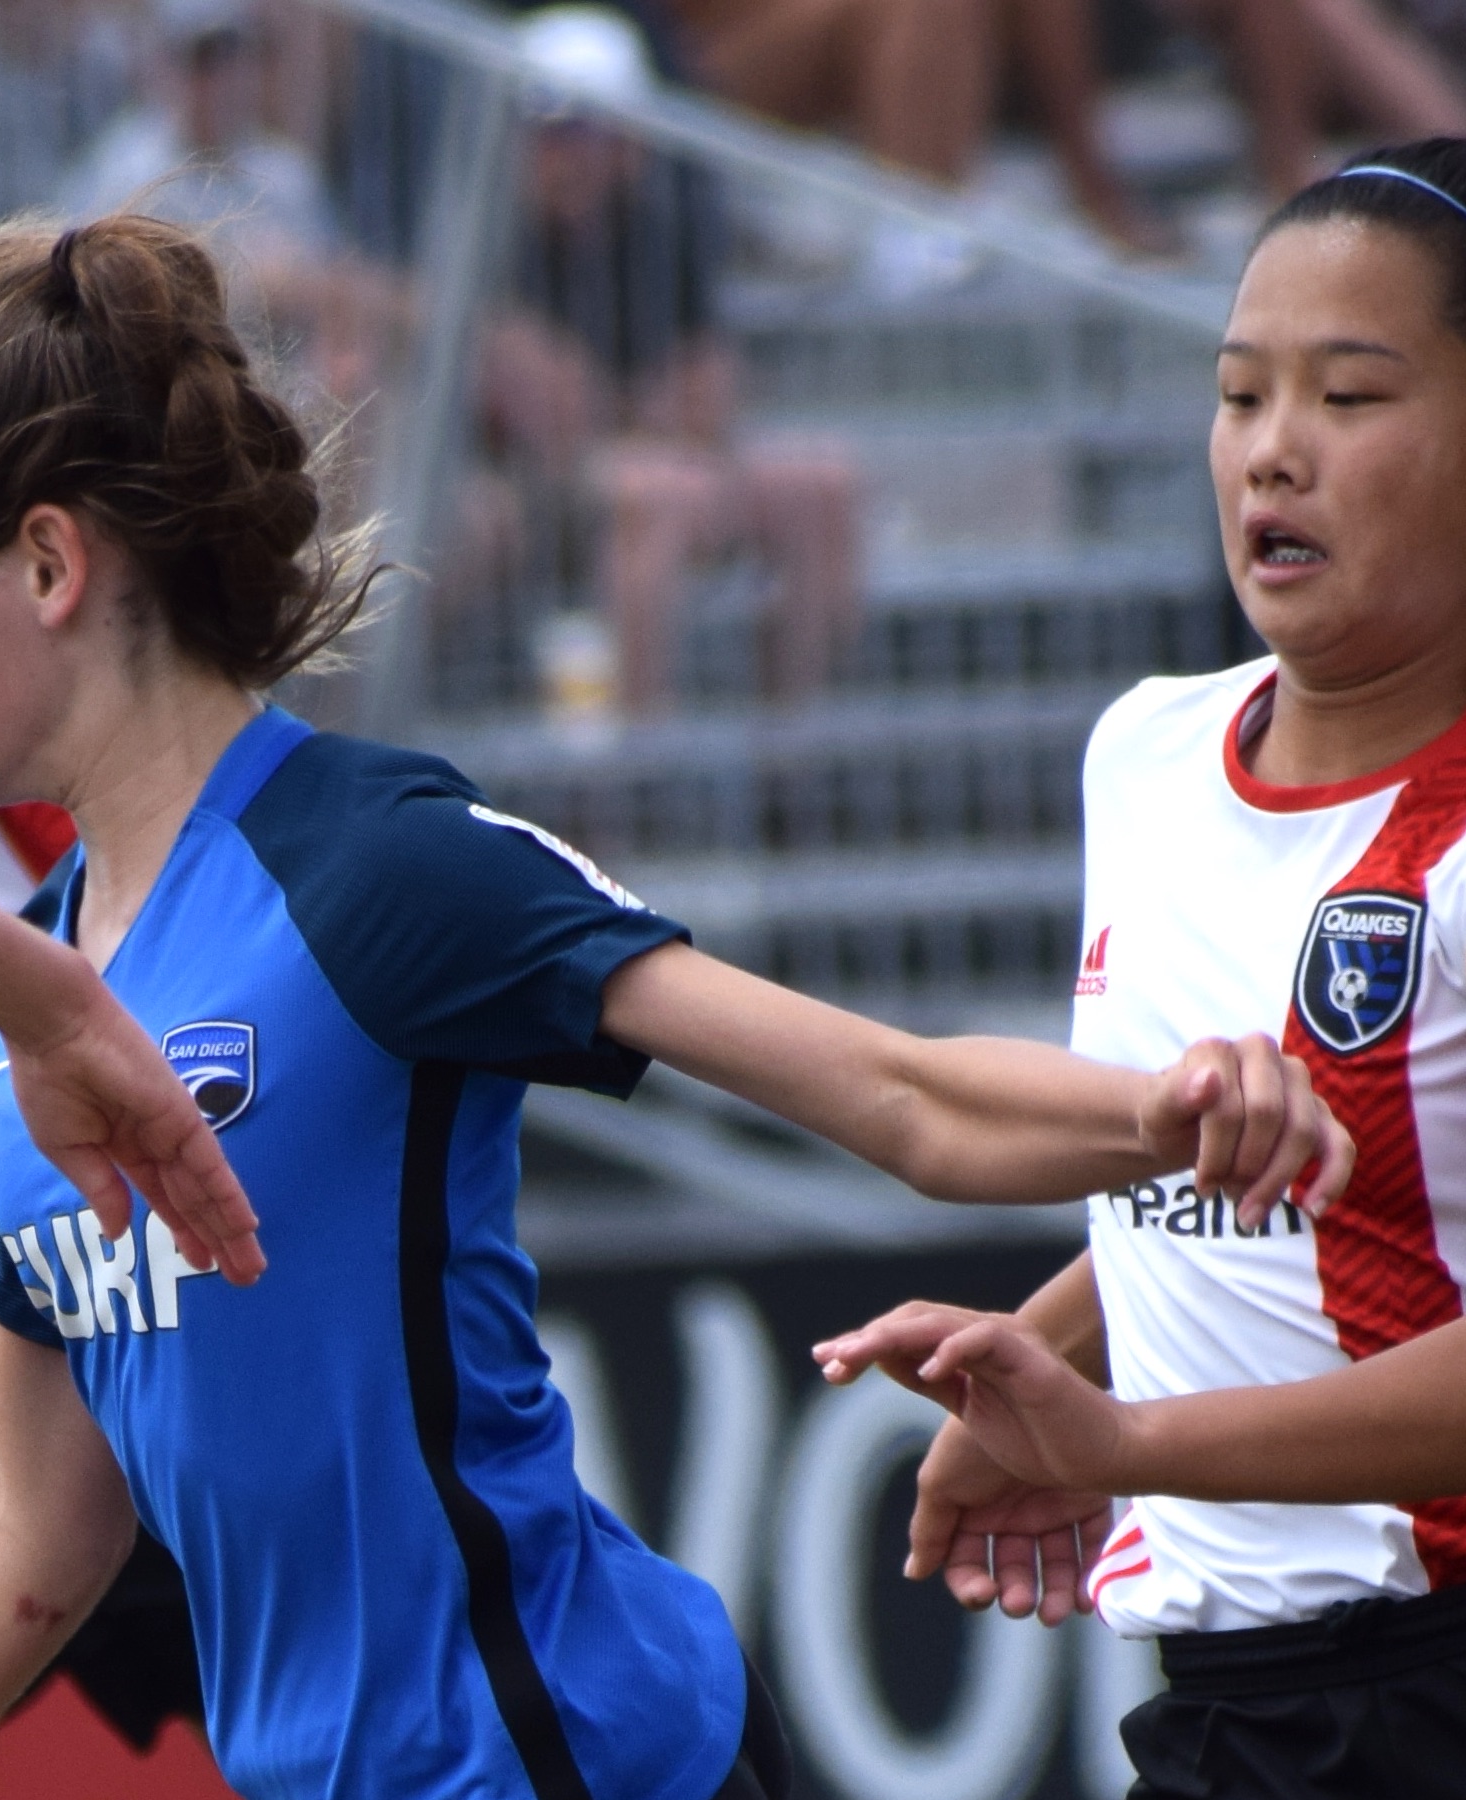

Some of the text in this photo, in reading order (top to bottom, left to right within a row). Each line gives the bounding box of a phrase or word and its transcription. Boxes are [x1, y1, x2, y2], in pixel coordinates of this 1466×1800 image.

[1323, 907, 1408, 936] QUAKES
[167, 1041, 246, 1060] SAN DIEGO
[1108, 1178, 1303, 1238] ealh
